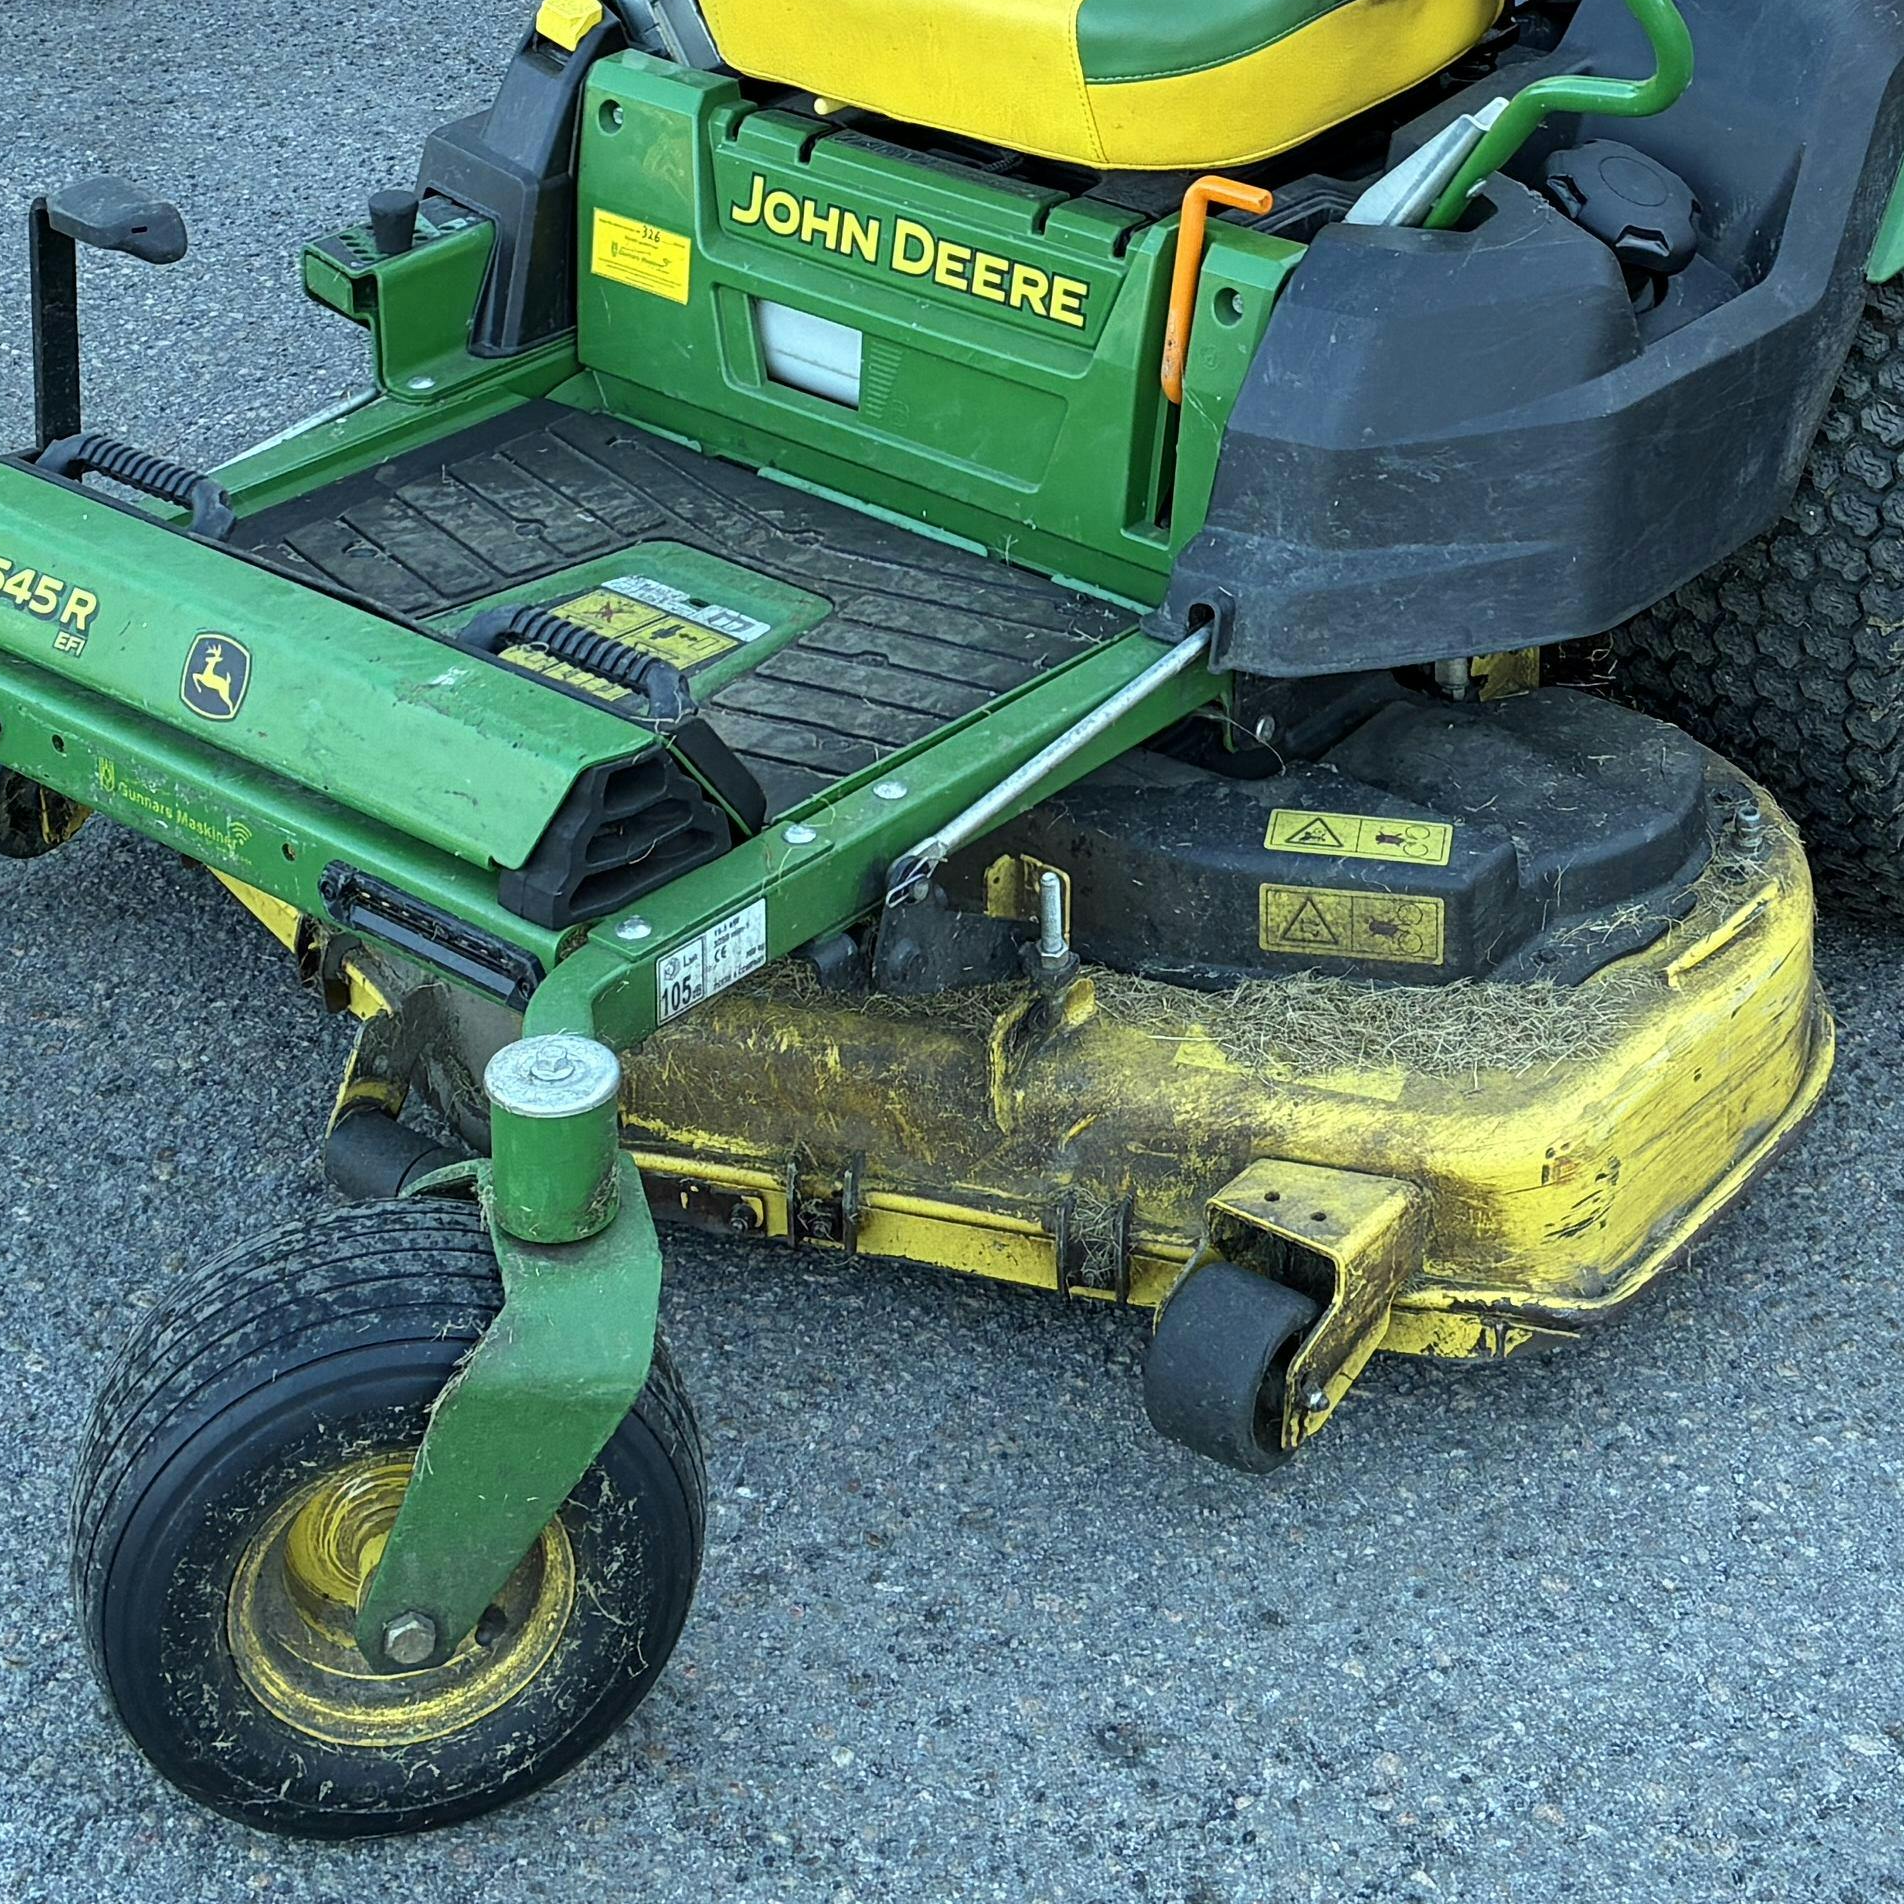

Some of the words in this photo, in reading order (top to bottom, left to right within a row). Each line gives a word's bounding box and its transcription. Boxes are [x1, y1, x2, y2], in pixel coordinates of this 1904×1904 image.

[641, 225, 661, 243] 326
[730, 175, 881, 264] JOHN
[891, 217, 1089, 328] DEERE
[59, 586, 97, 631] R
[54, 631, 87, 656] EFI
[118, 781, 173, 819] Gunnars
[714, 944, 727, 963] CE
[662, 975, 692, 1017] 105
